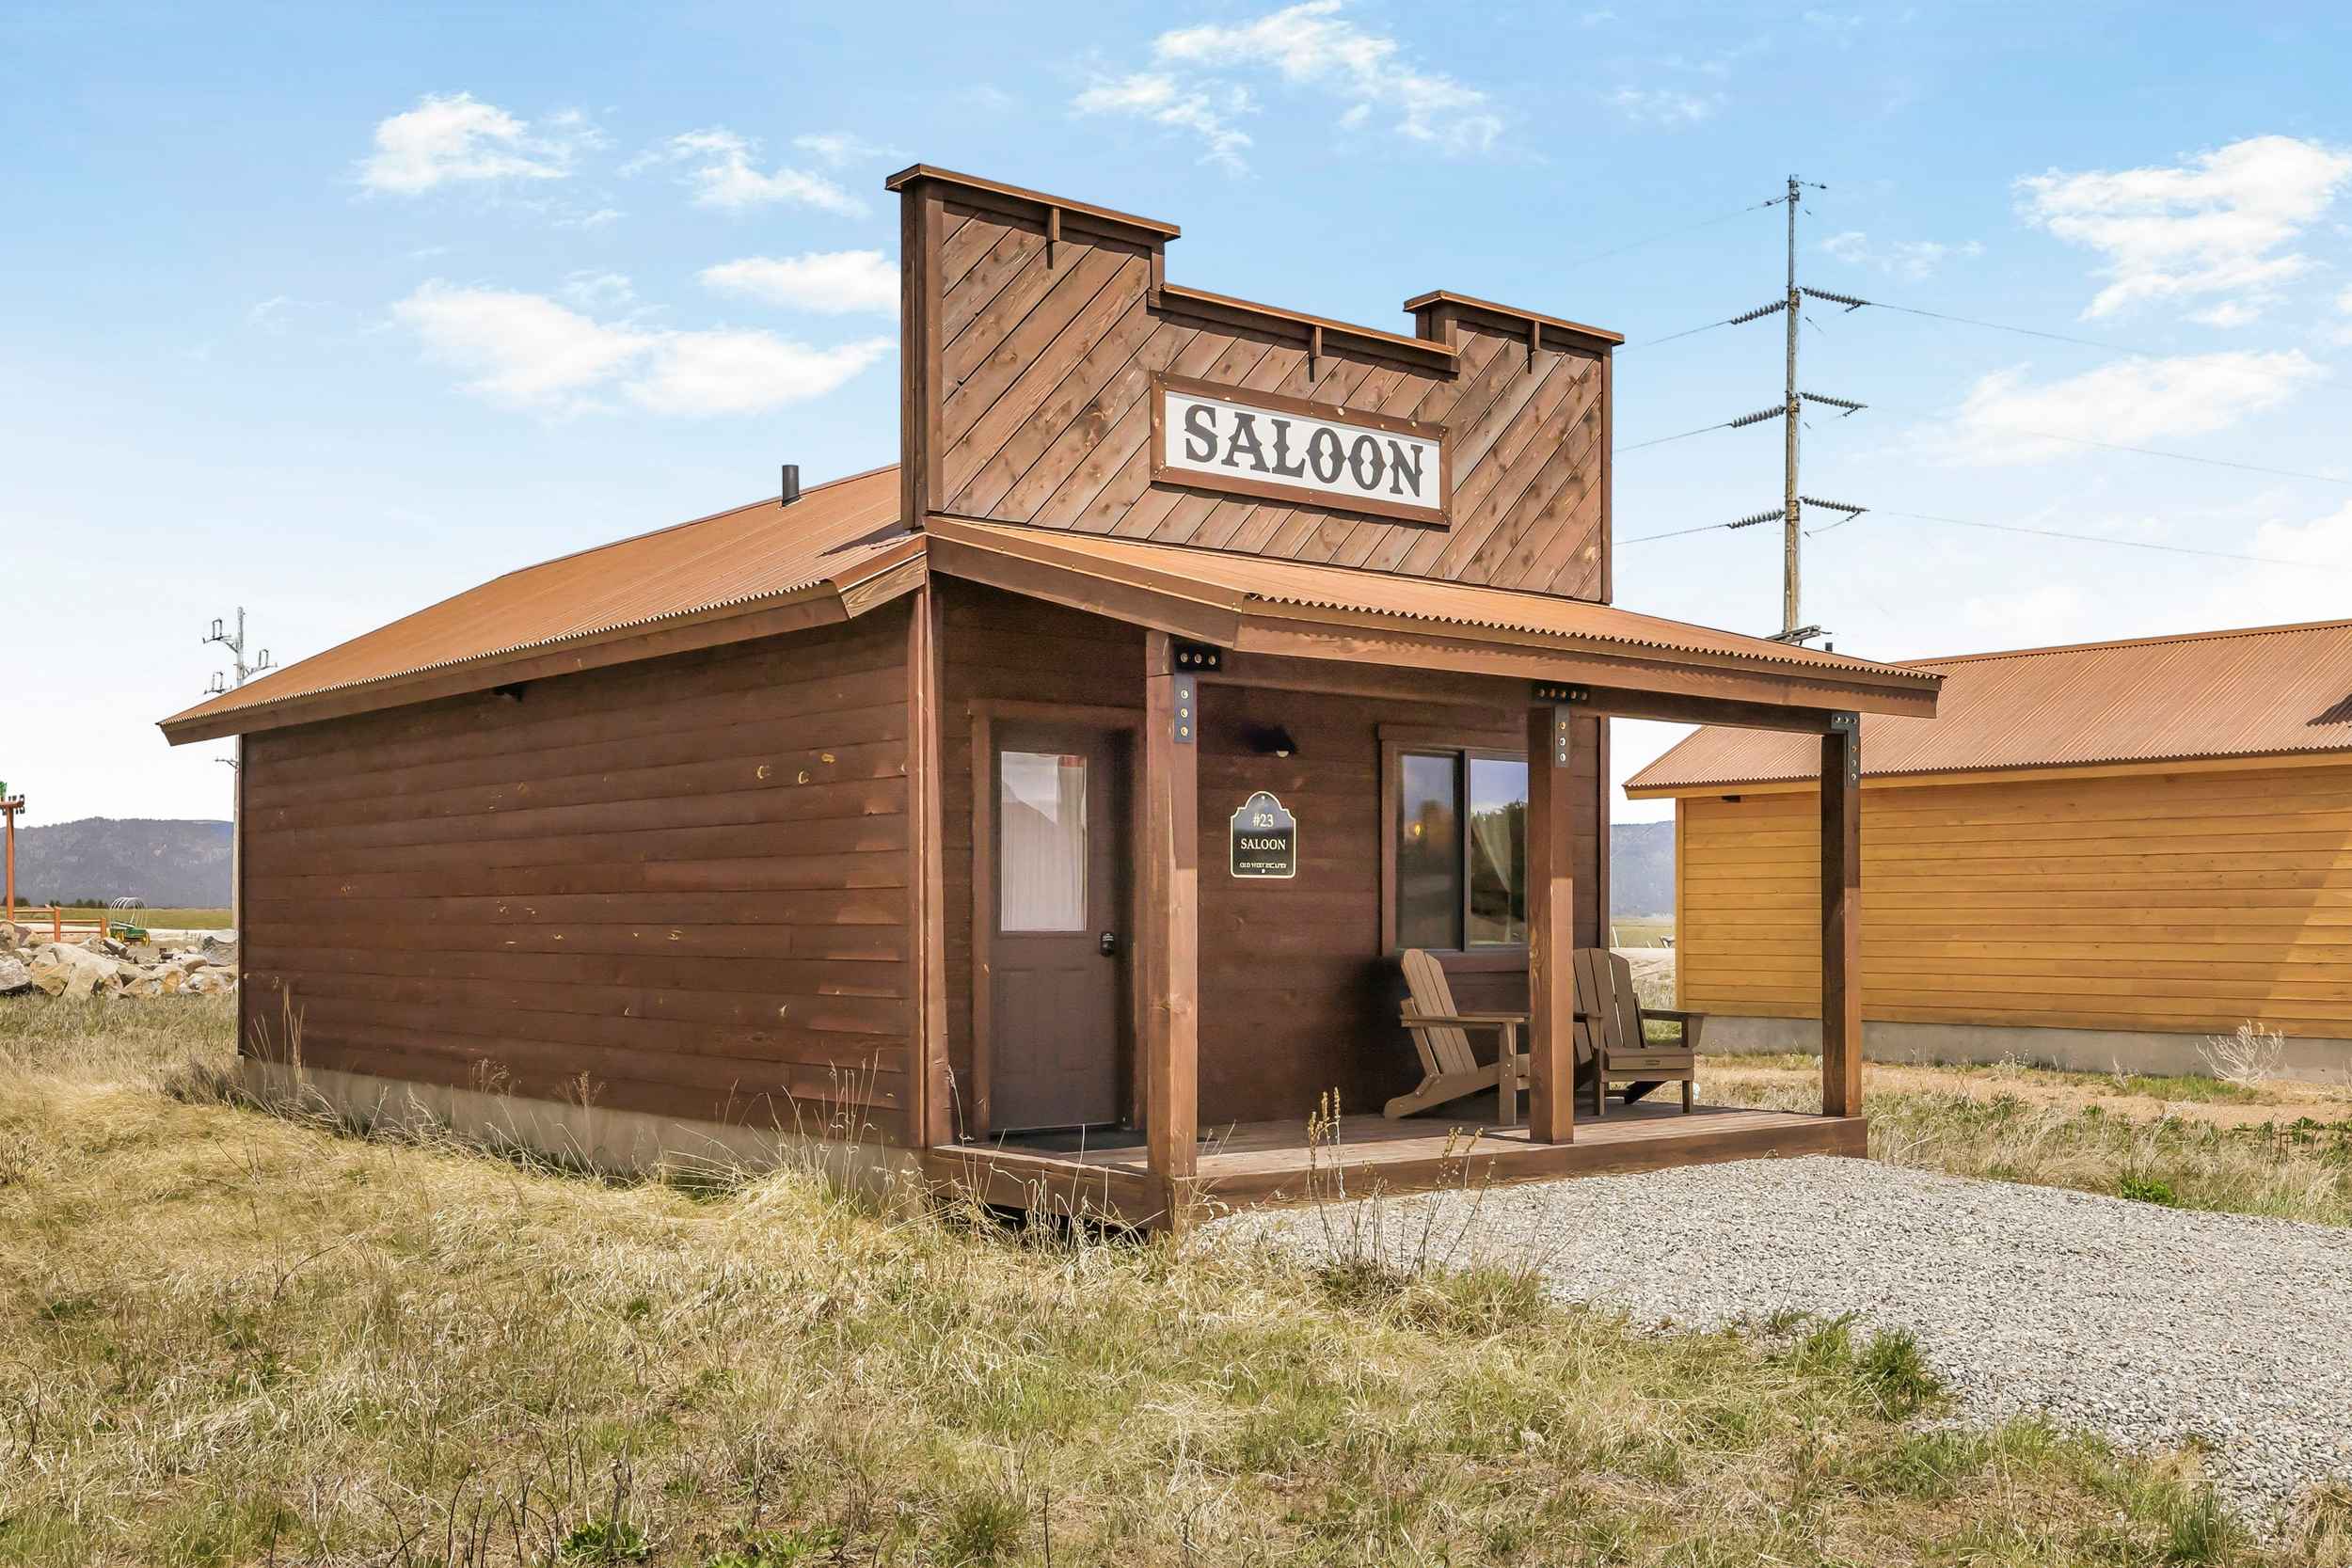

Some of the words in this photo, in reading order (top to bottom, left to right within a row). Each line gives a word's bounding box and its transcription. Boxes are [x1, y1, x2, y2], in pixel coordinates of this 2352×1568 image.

[1184, 404, 1423, 497] SALOON
[1252, 813, 1274, 828] #23
[1240, 838, 1286, 850] SALOON
